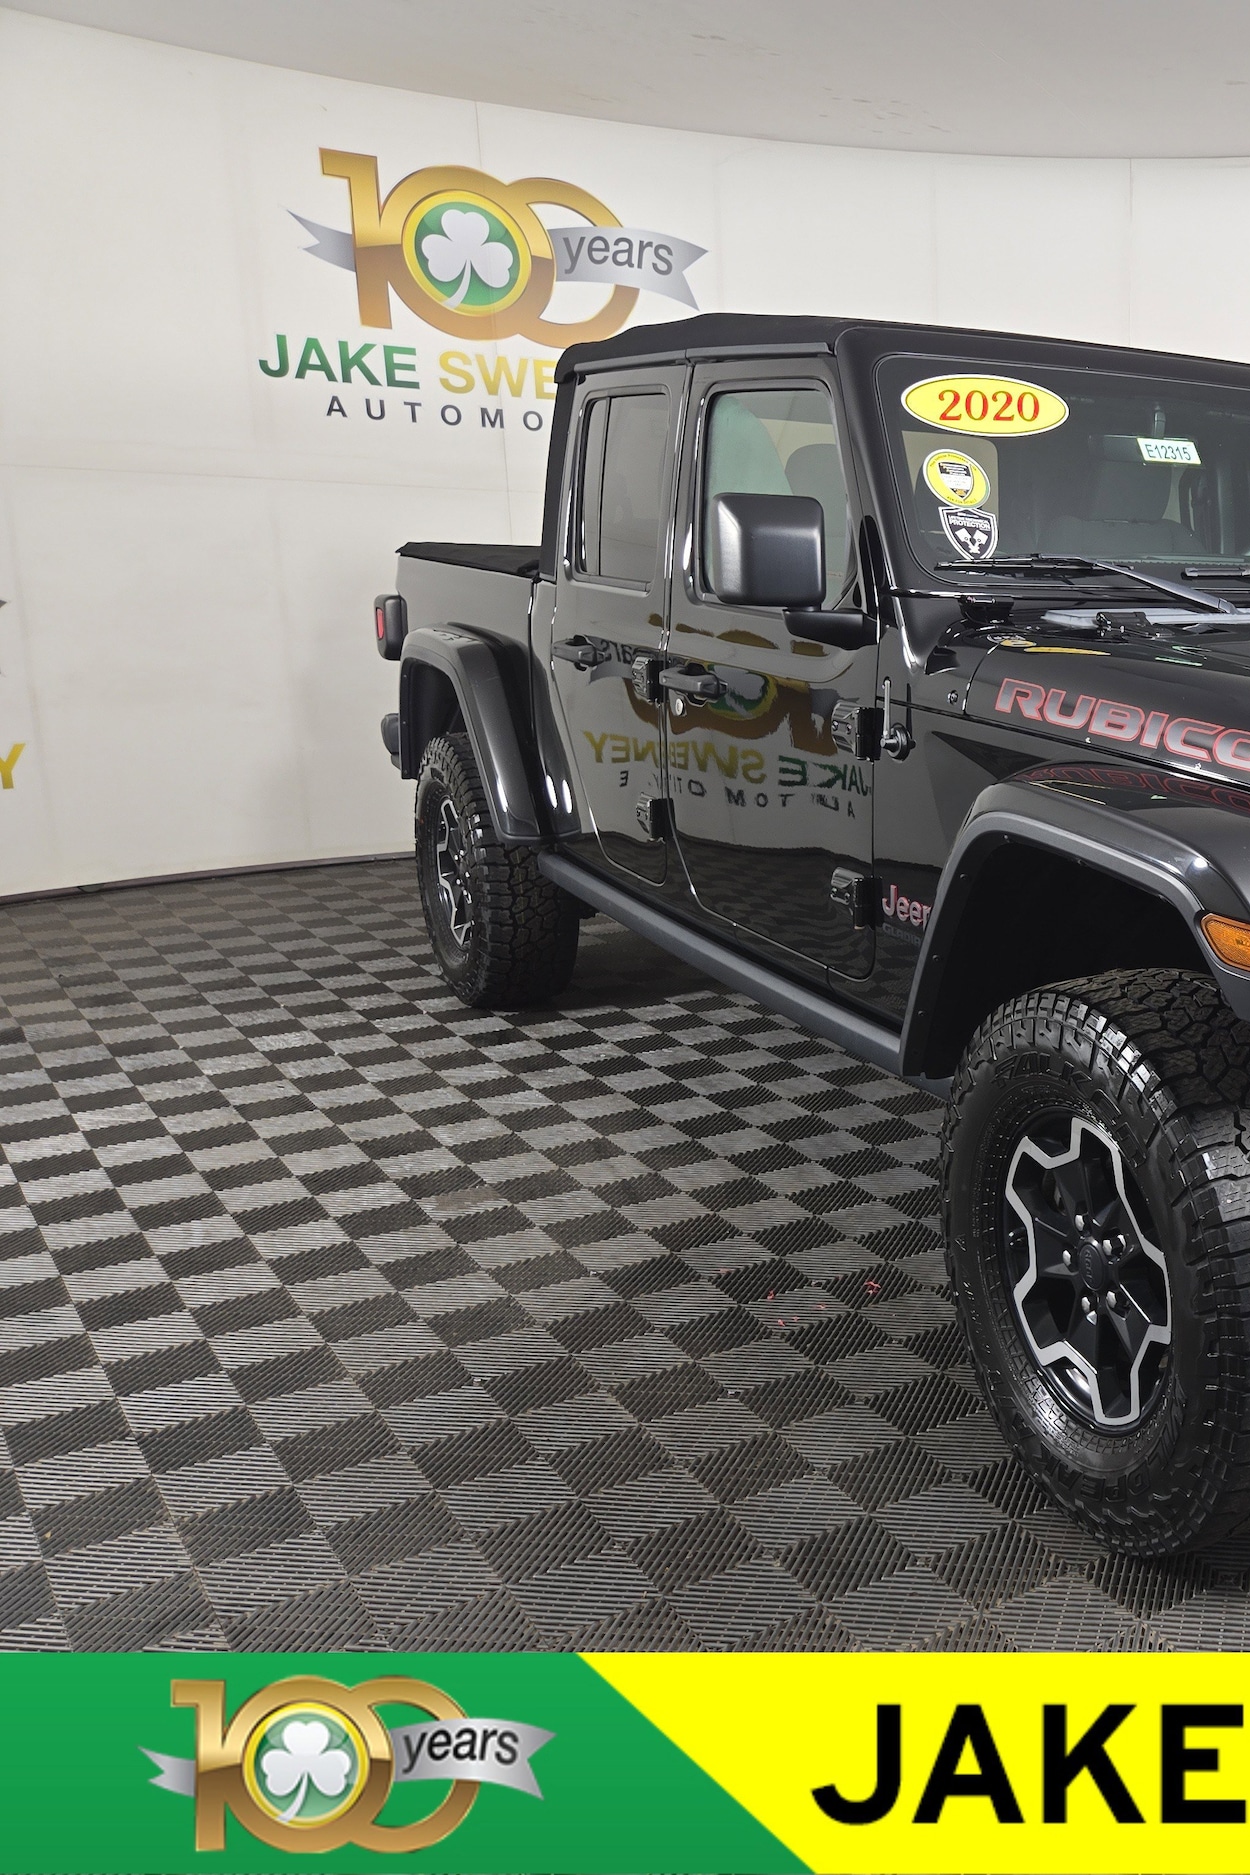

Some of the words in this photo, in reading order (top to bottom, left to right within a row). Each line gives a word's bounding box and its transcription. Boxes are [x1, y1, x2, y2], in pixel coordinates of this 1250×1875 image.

[562, 236, 674, 276] years
[258, 333, 420, 390] JAKE
[326, 395, 543, 432] AUTOMO
[938, 390, 1040, 422] 2020
[1145, 444, 1191, 461] E12315
